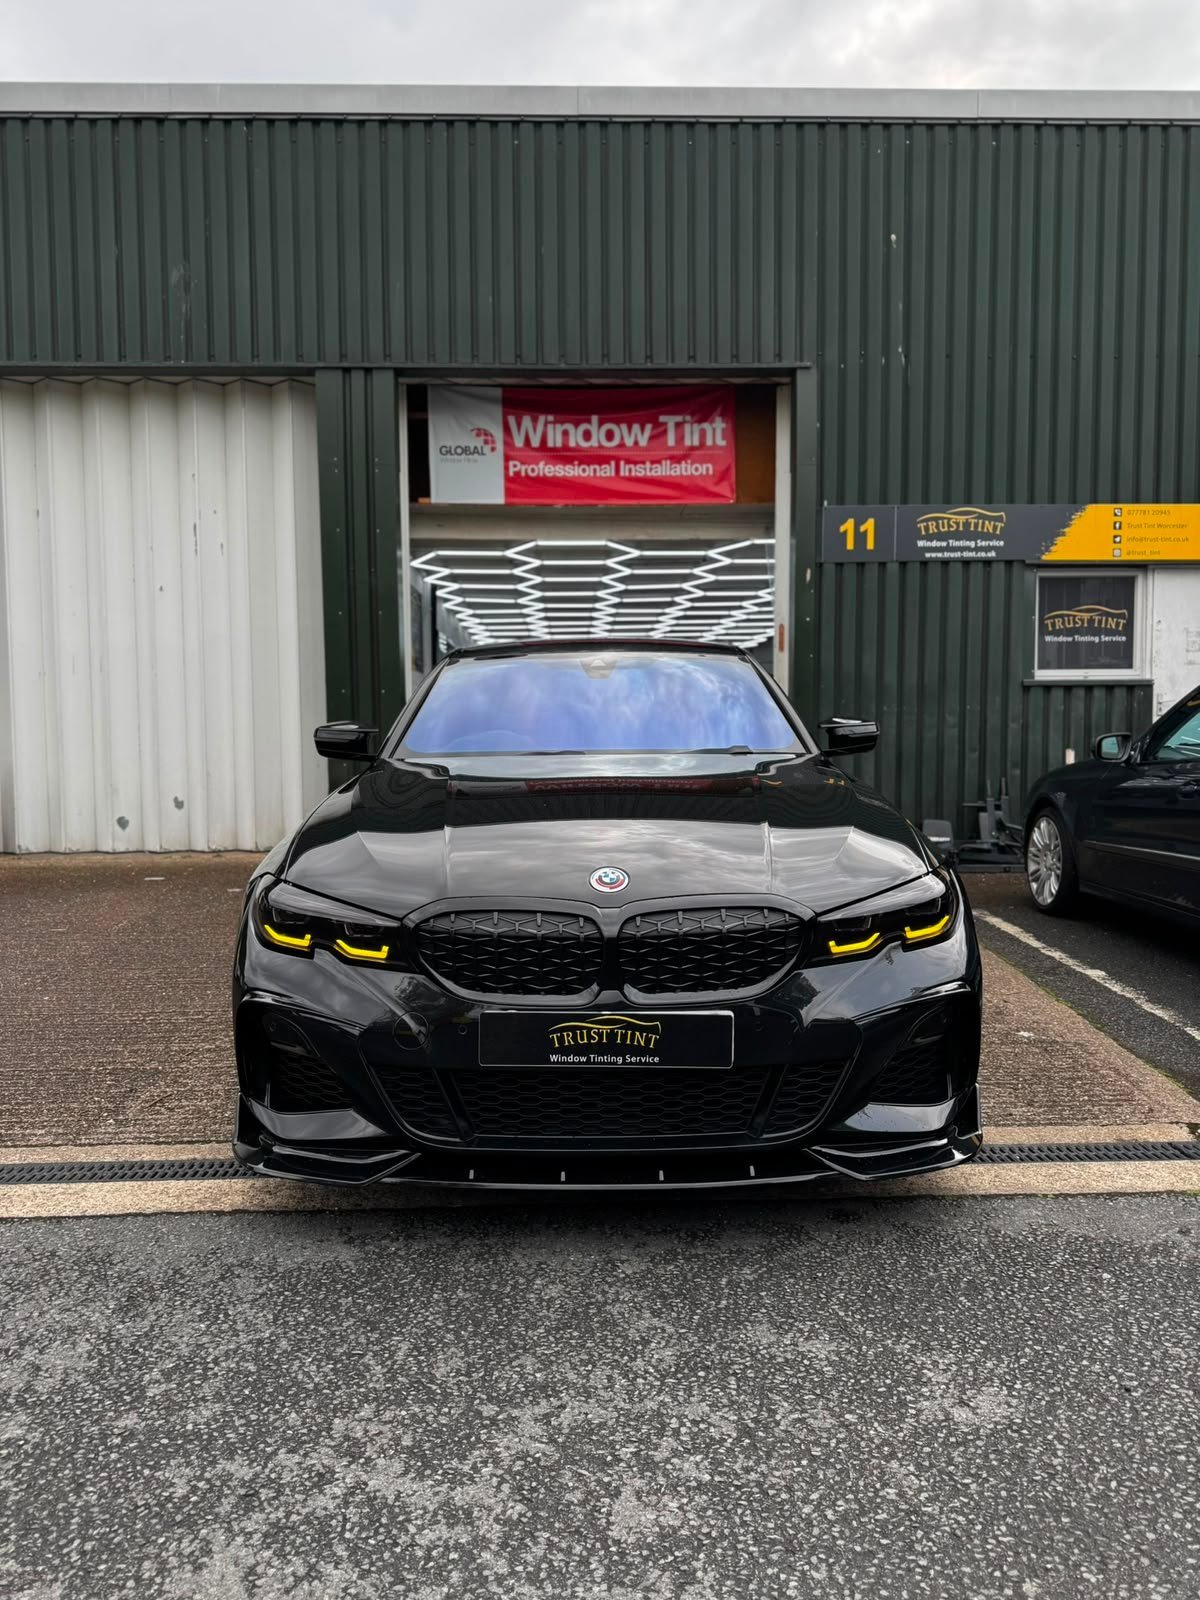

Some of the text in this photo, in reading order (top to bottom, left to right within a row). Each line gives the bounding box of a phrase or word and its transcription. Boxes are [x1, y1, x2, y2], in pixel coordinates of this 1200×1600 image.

[507, 414, 727, 448] Window Tint
[439, 445, 486, 456] GLOBAL
[508, 459, 714, 477] Professional Installation
[839, 517, 875, 550] 11
[917, 518, 1005, 535] TRUST TINT
[917, 540, 947, 548] Window
[948, 540, 976, 549] Tinting
[925, 550, 997, 558] www.trust-tint.co.uk
[1044, 615, 1127, 631] TRUST TINT
[1074, 635, 1099, 643] Tinting
[549, 1029, 660, 1048] TRUST TINT
[549, 1054, 660, 1064] Window Tinting Service
